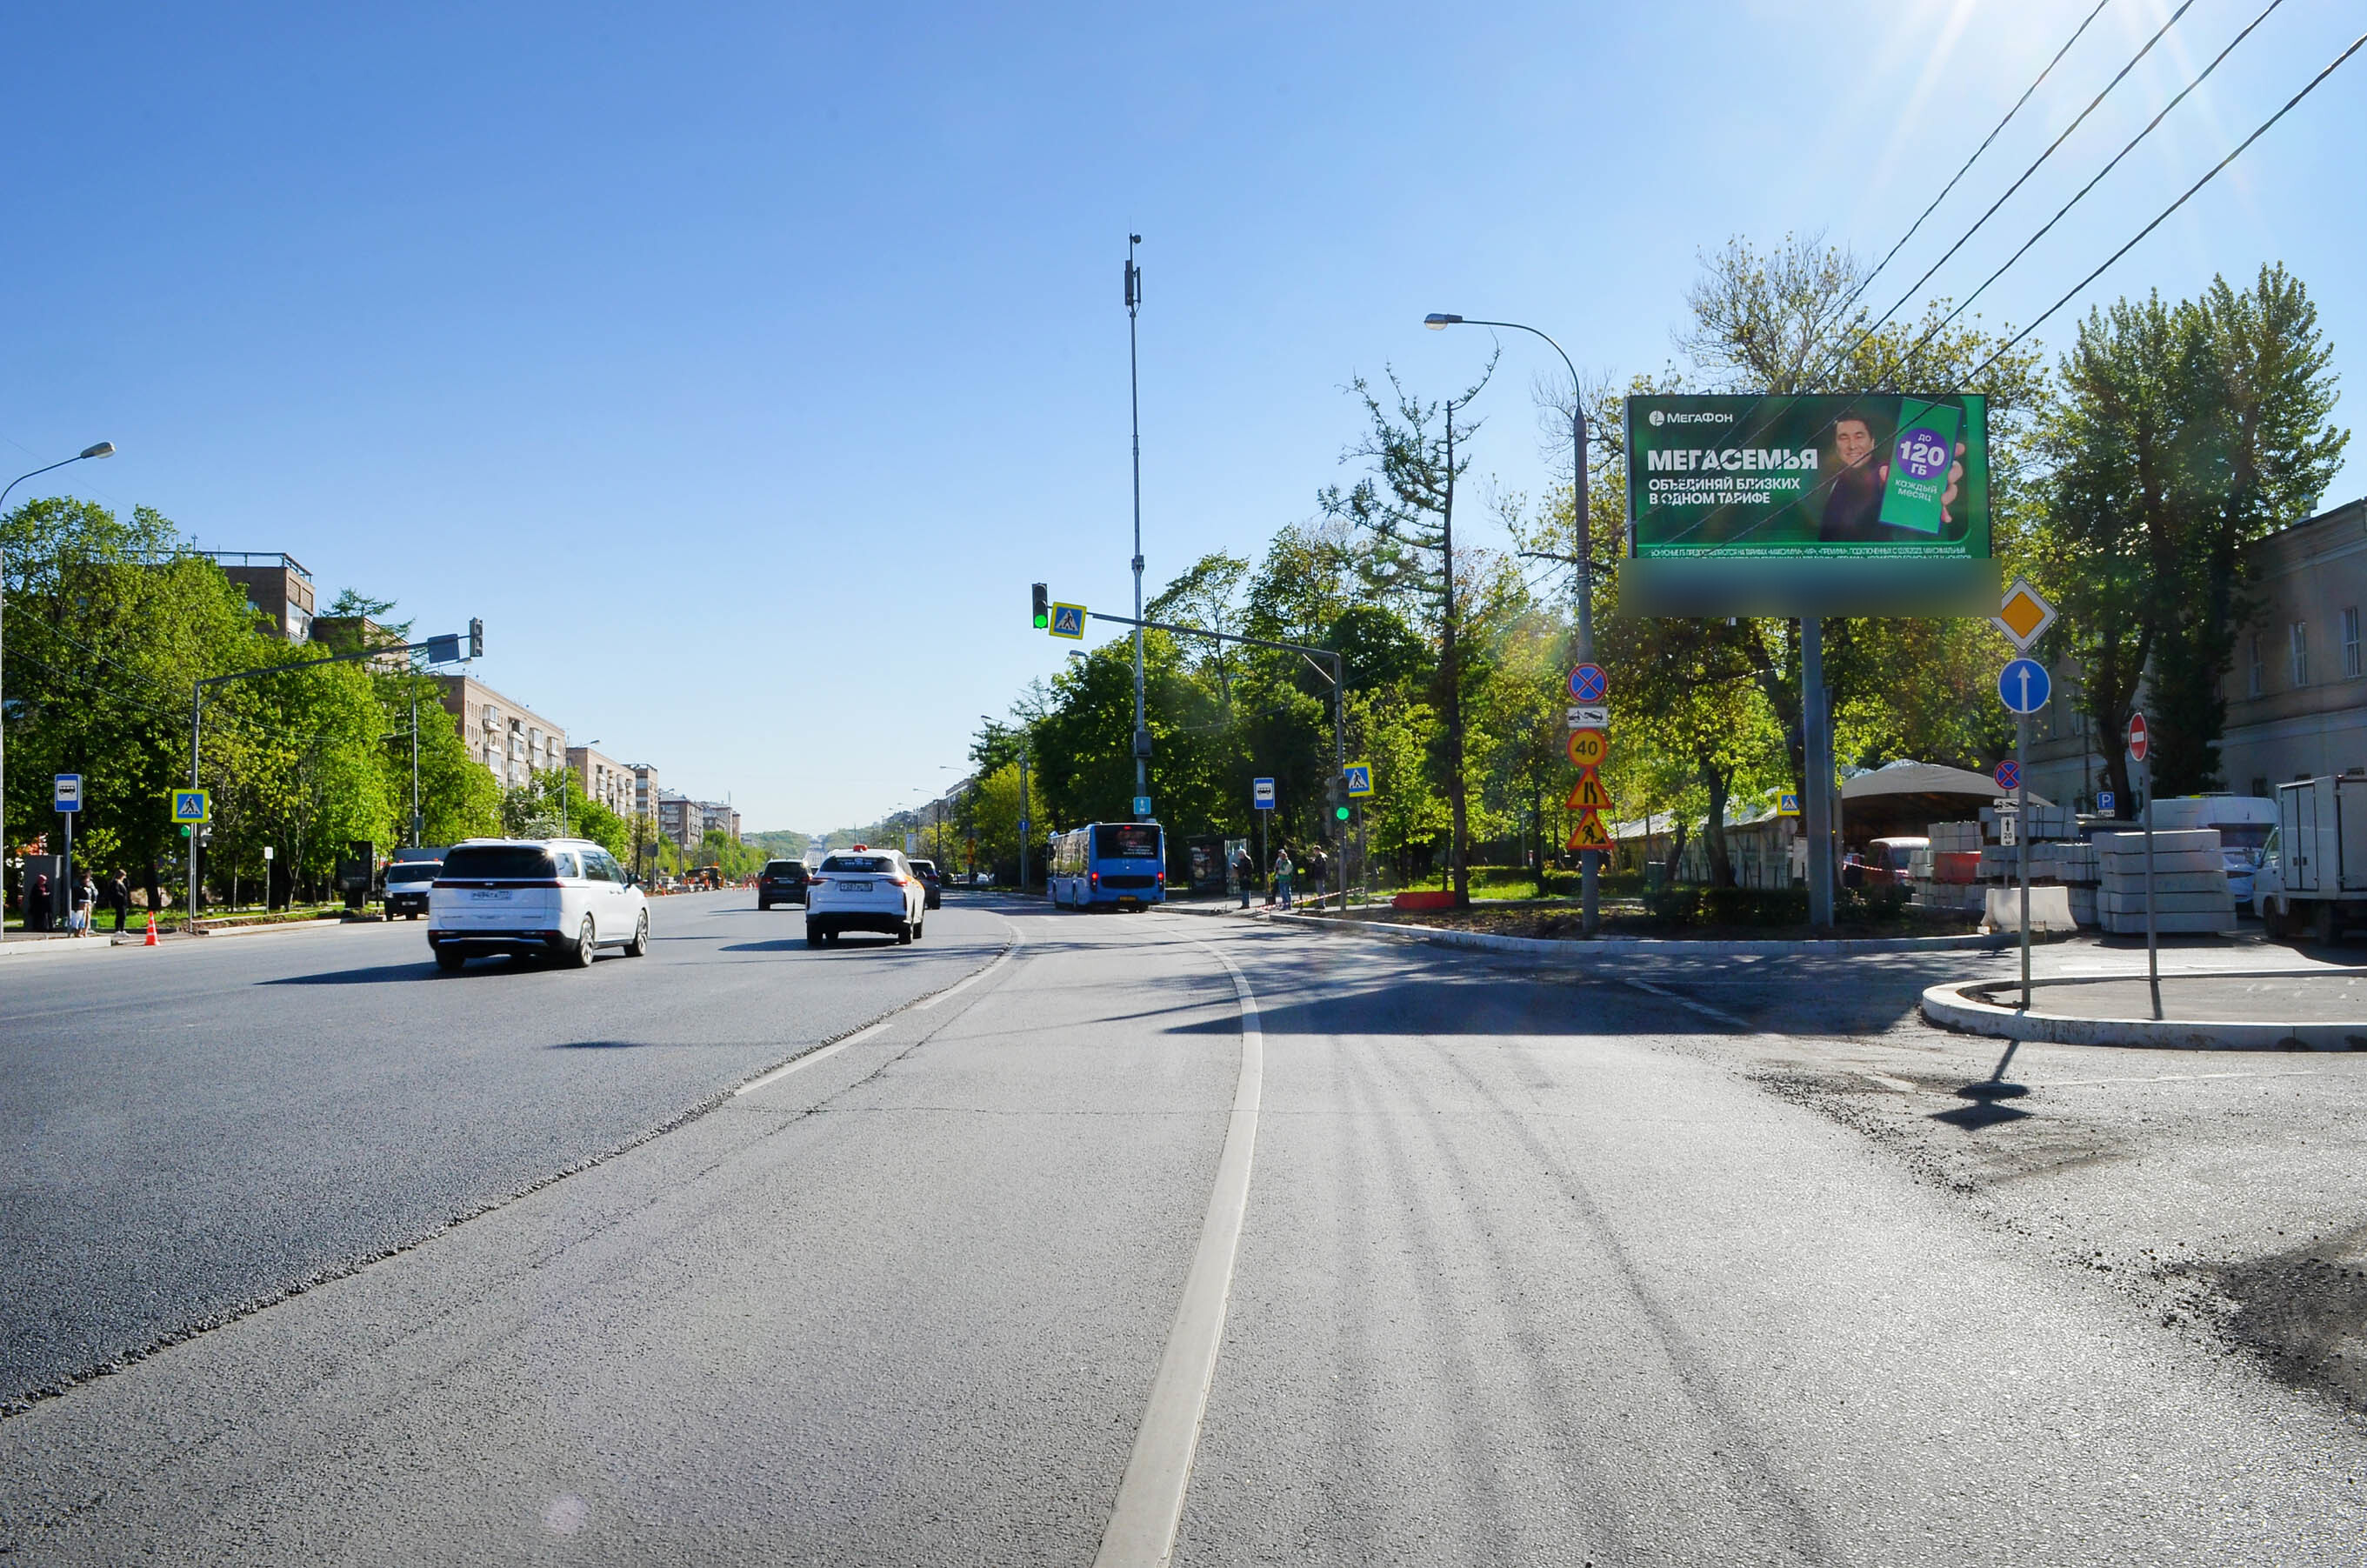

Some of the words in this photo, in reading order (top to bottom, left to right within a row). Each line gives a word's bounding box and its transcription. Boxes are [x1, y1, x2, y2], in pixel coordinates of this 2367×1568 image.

[1647, 448, 1818, 471] МЕГАСЕМЬЯ
[1900, 441, 1945, 467] 120
[1910, 463, 1927, 476] ГБ
[1648, 477, 1733, 492] ОБЪЕДИНЯЙ
[1736, 477, 1801, 490] БЛИЗКИХ
[1895, 479, 1937, 494] каждый
[1649, 492, 1658, 504] В
[1661, 492, 1715, 506] ОДНОМ
[1717, 491, 1770, 504] ТАРИФЕ
[1575, 739, 1598, 756] 40
